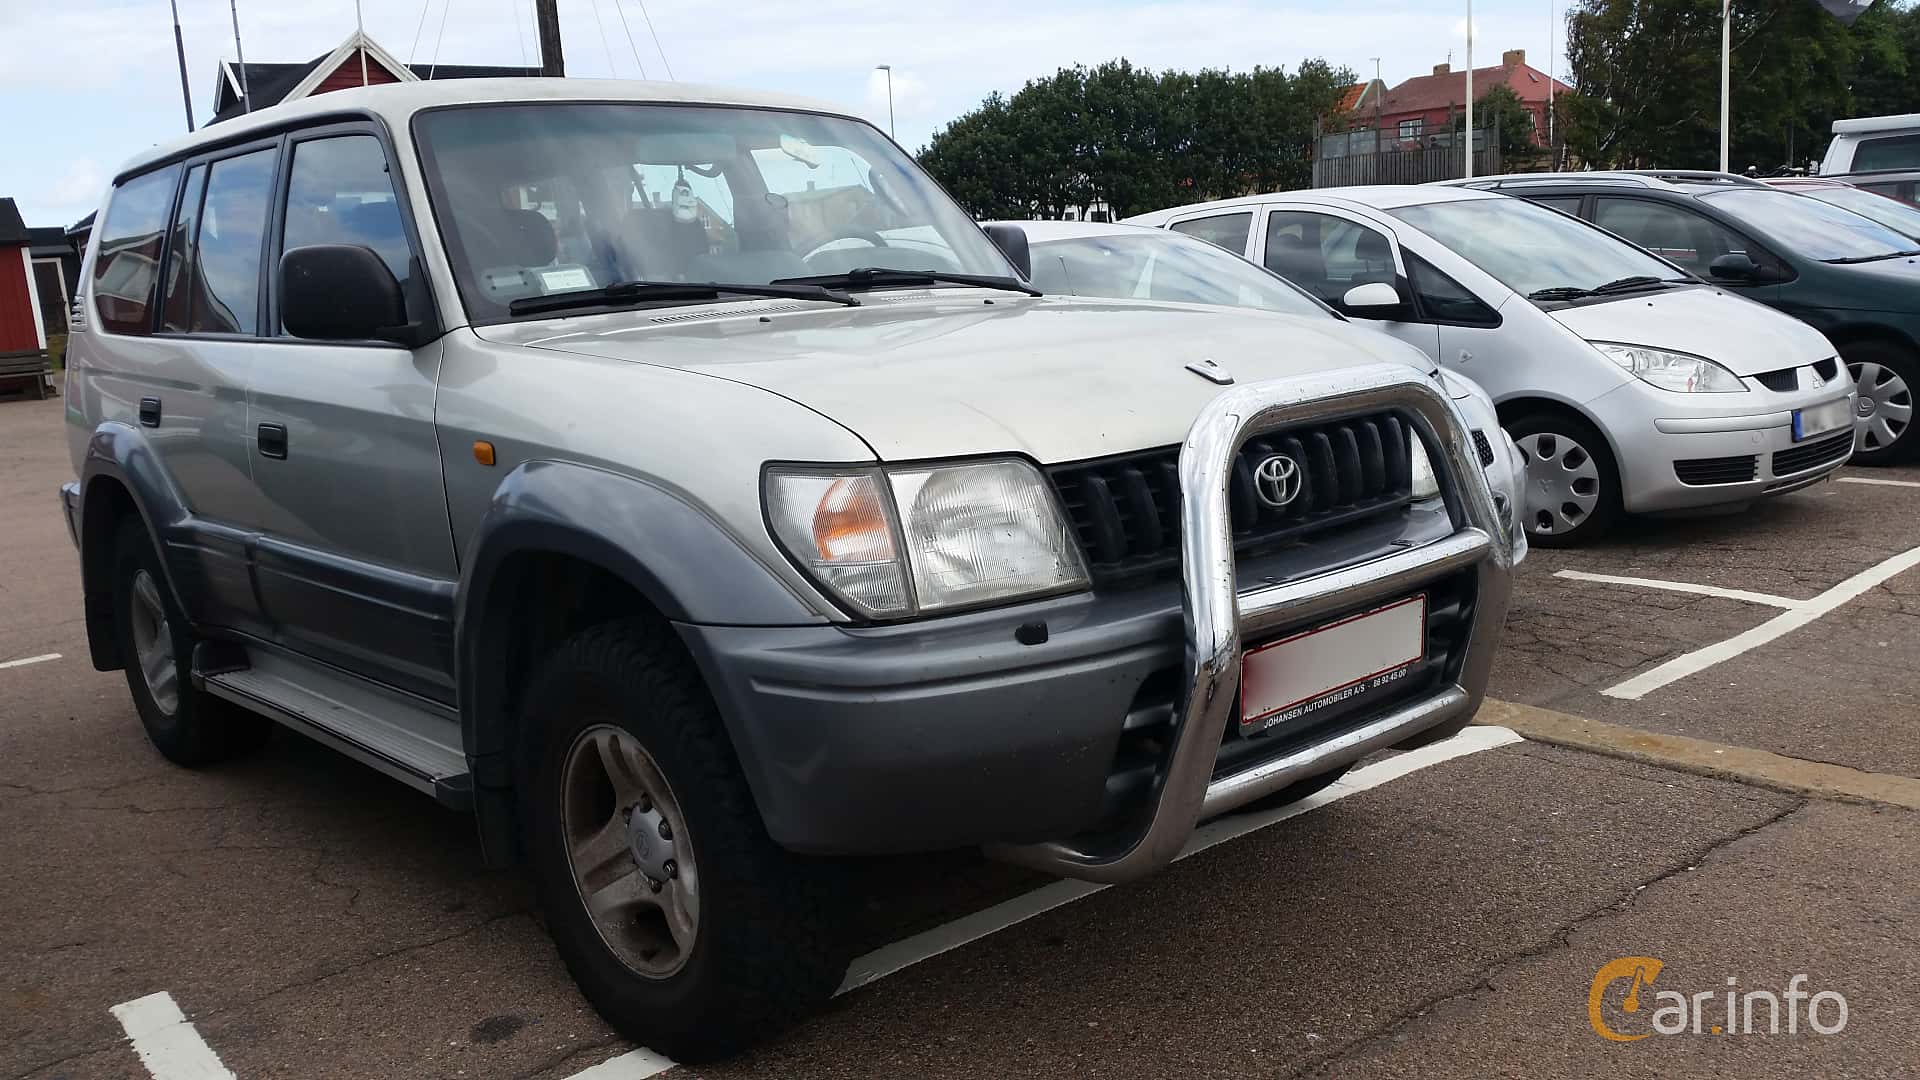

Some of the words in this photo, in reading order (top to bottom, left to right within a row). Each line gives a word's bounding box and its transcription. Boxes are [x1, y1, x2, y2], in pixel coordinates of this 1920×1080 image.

[1263, 708, 1303, 729] JOHANSEN
[1303, 688, 1353, 715] AUTOMOBILER
[1354, 683, 1365, 696] A/S
